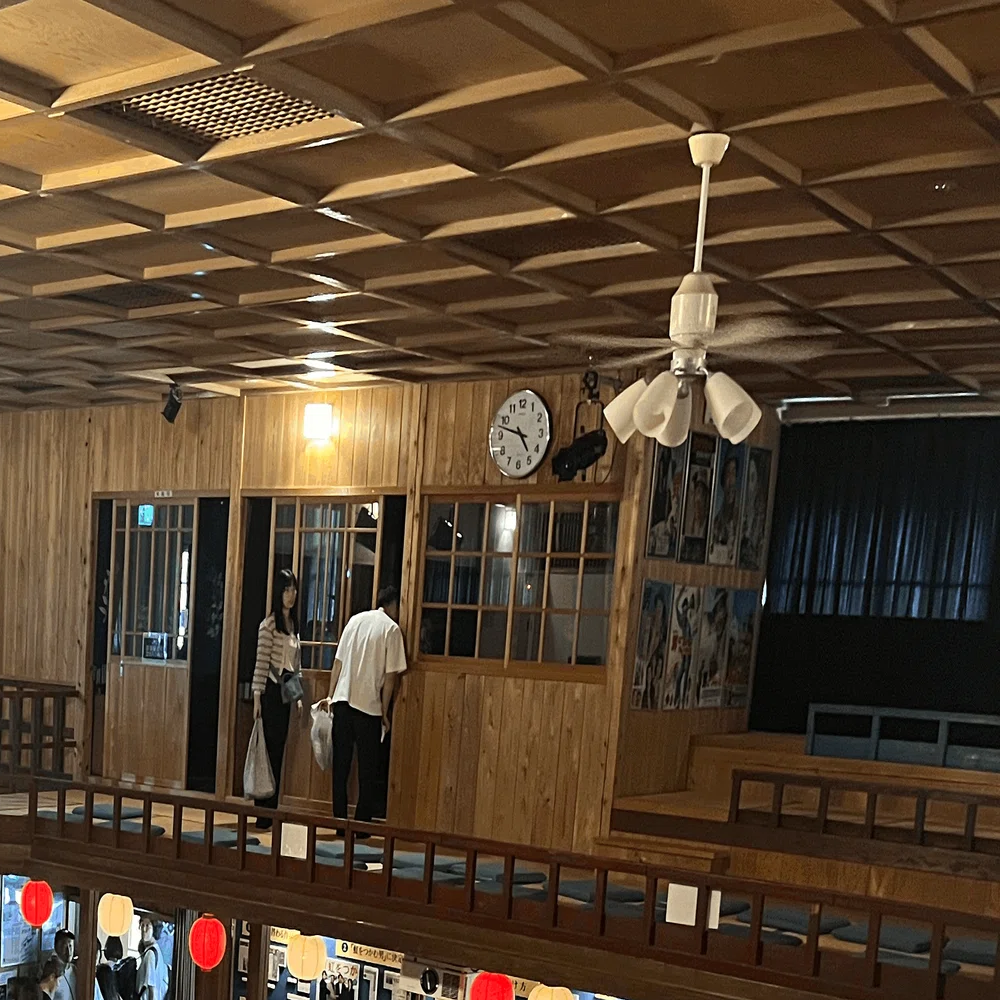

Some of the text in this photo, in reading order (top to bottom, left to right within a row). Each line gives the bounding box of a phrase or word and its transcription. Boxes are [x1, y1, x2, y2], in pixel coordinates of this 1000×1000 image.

[509, 404, 516, 413] 11
[519, 399, 527, 409] 12
[531, 402, 535, 412] 1
[501, 416, 510, 425] 10
[537, 413, 543, 423] 2
[498, 431, 503, 440] 9
[538, 429, 544, 438] 3
[500, 446, 506, 455] 8
[534, 444, 540, 453] 4
[506, 456, 511, 466] 7
[516, 459, 521, 469] 6
[526, 456, 532, 465] 5
